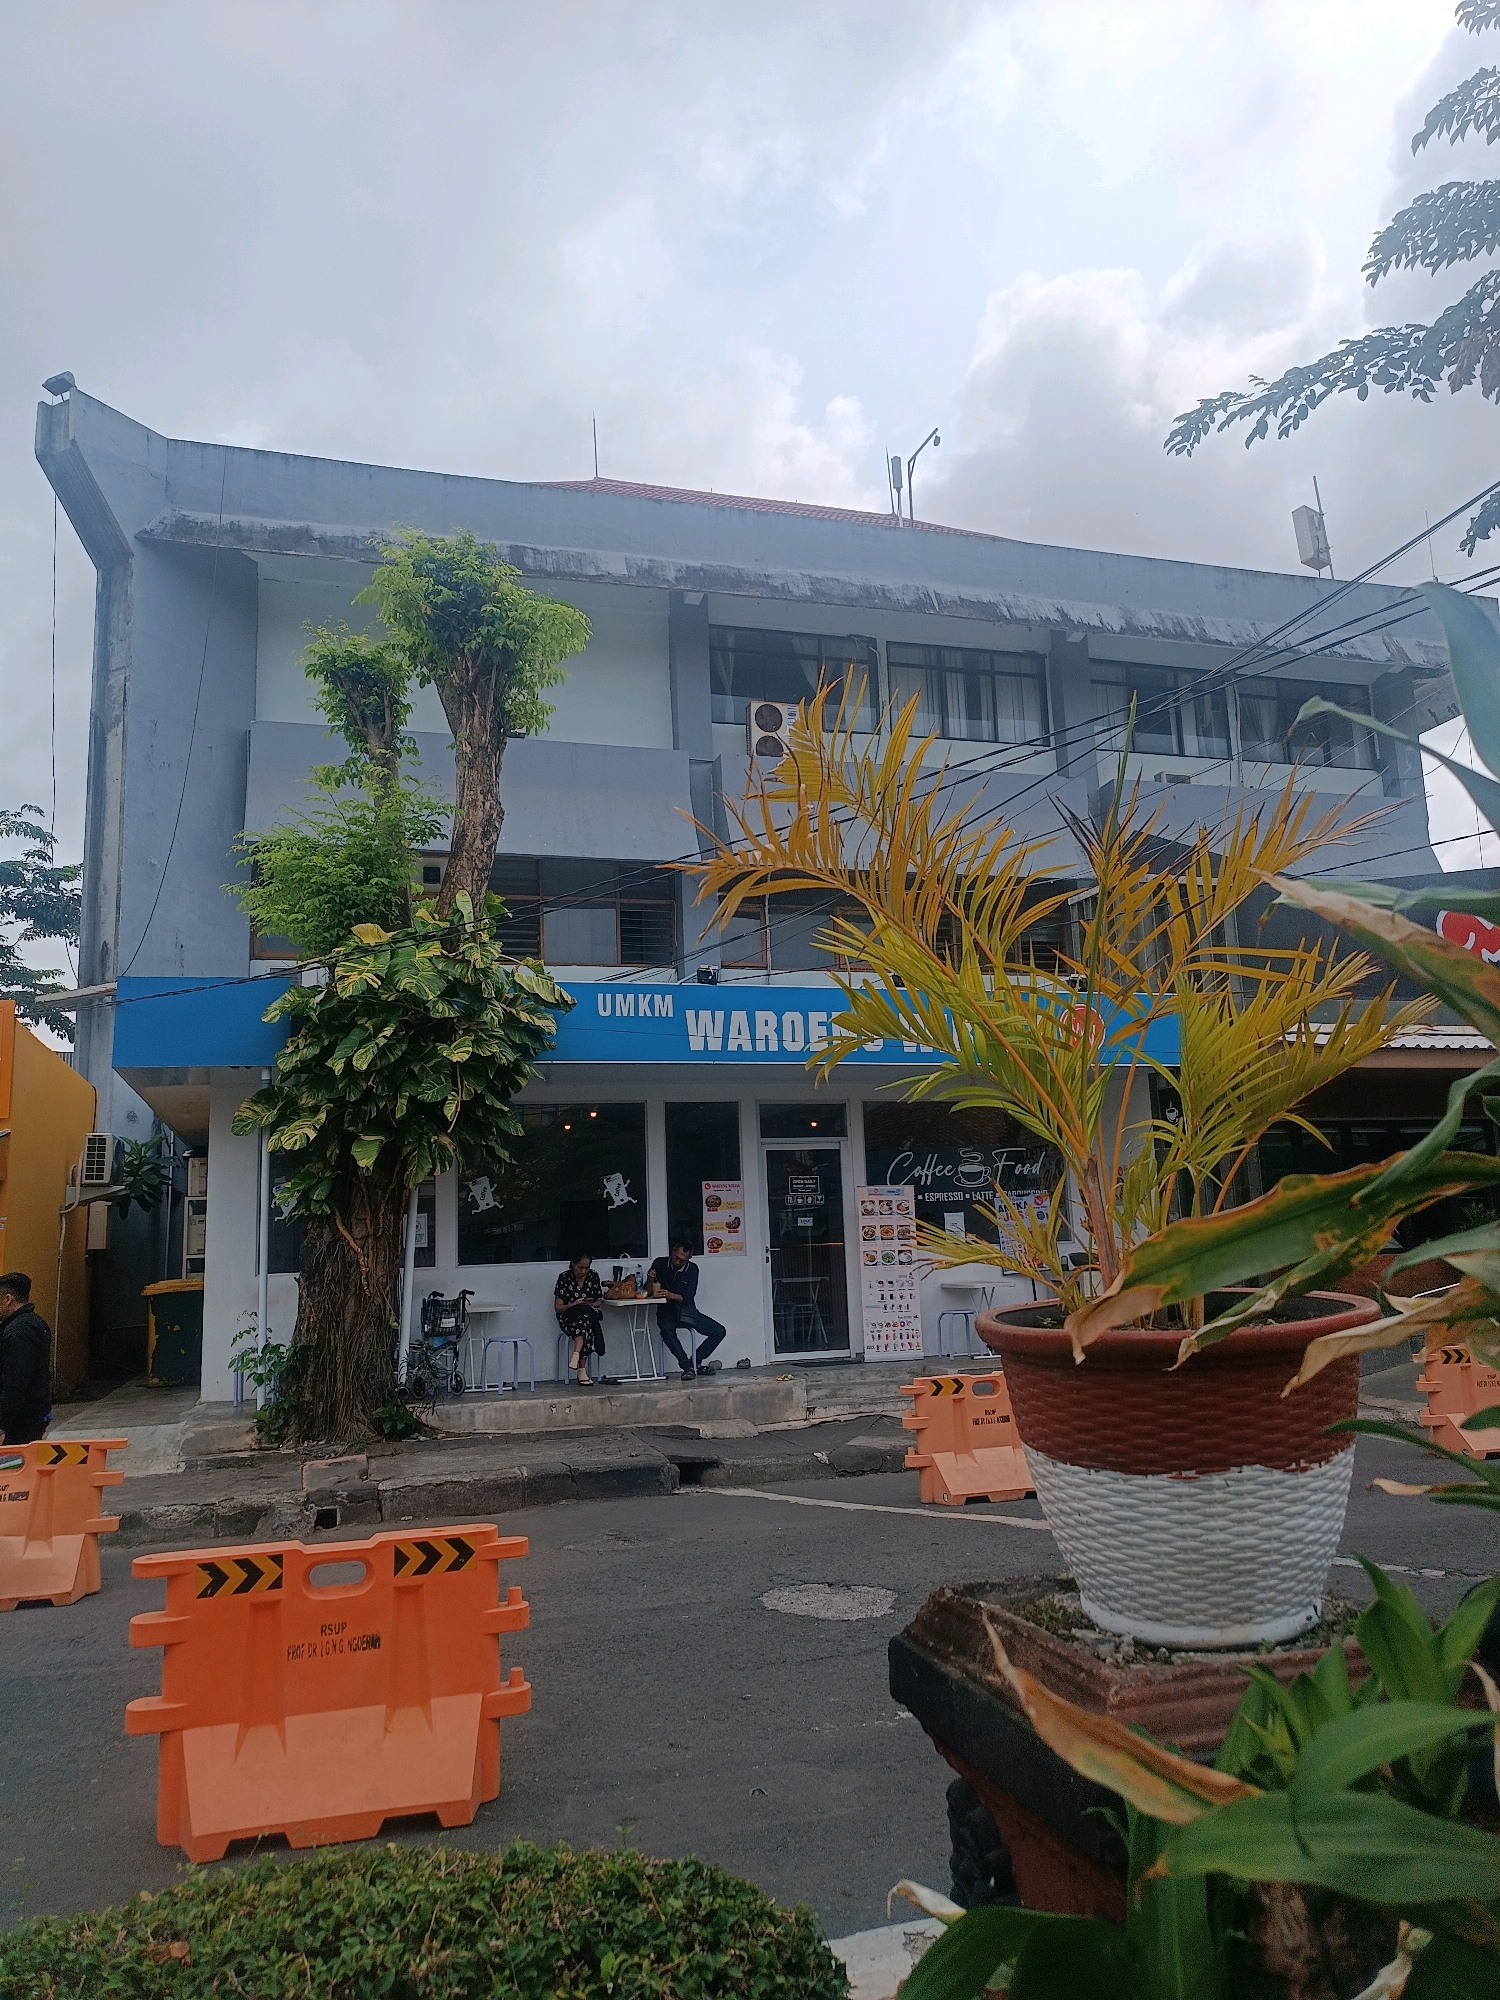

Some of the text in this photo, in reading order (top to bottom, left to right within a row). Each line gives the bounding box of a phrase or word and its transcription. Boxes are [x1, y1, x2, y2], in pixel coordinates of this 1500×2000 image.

[597, 993, 674, 1018] UMKM
[886, 1147, 1046, 1186] Coffee Food
[925, 1191, 964, 1202] ESPRESSO
[972, 1190, 994, 1202] LATTE
[998, 1200, 1029, 1213] ANKA
[320, 1621, 348, 1637] RSUP
